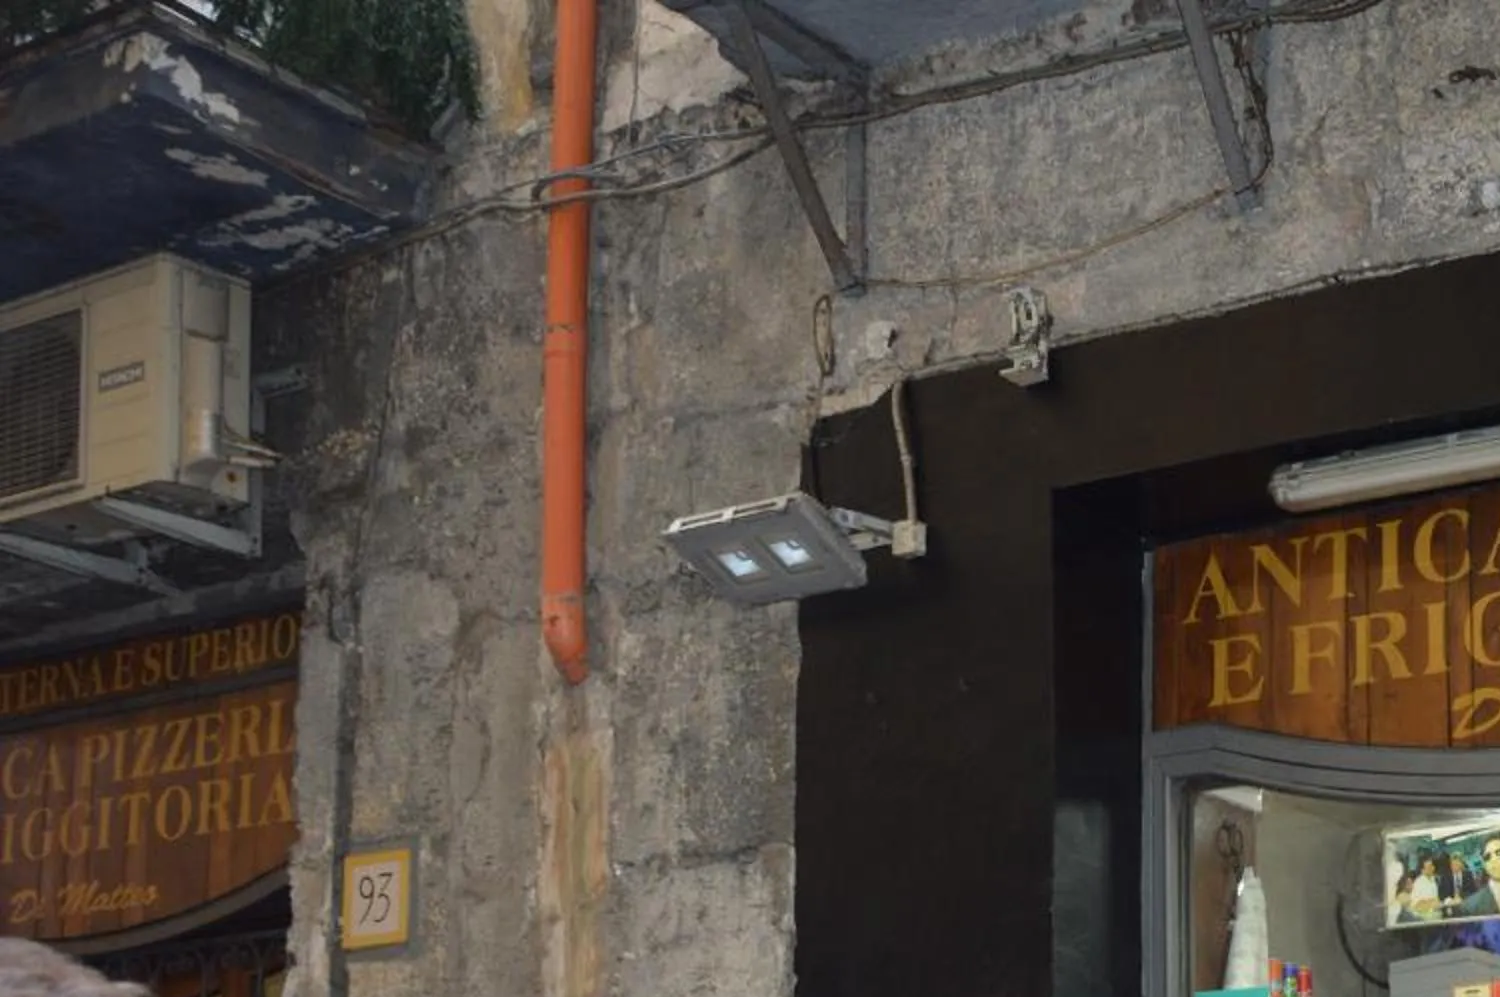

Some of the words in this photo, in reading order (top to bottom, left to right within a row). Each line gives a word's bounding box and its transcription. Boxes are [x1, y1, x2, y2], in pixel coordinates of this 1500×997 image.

[112, 649, 135, 691] E
[1207, 634, 1264, 708] E
[81, 699, 295, 788] PIZZERI
[358, 872, 394, 924] 93
